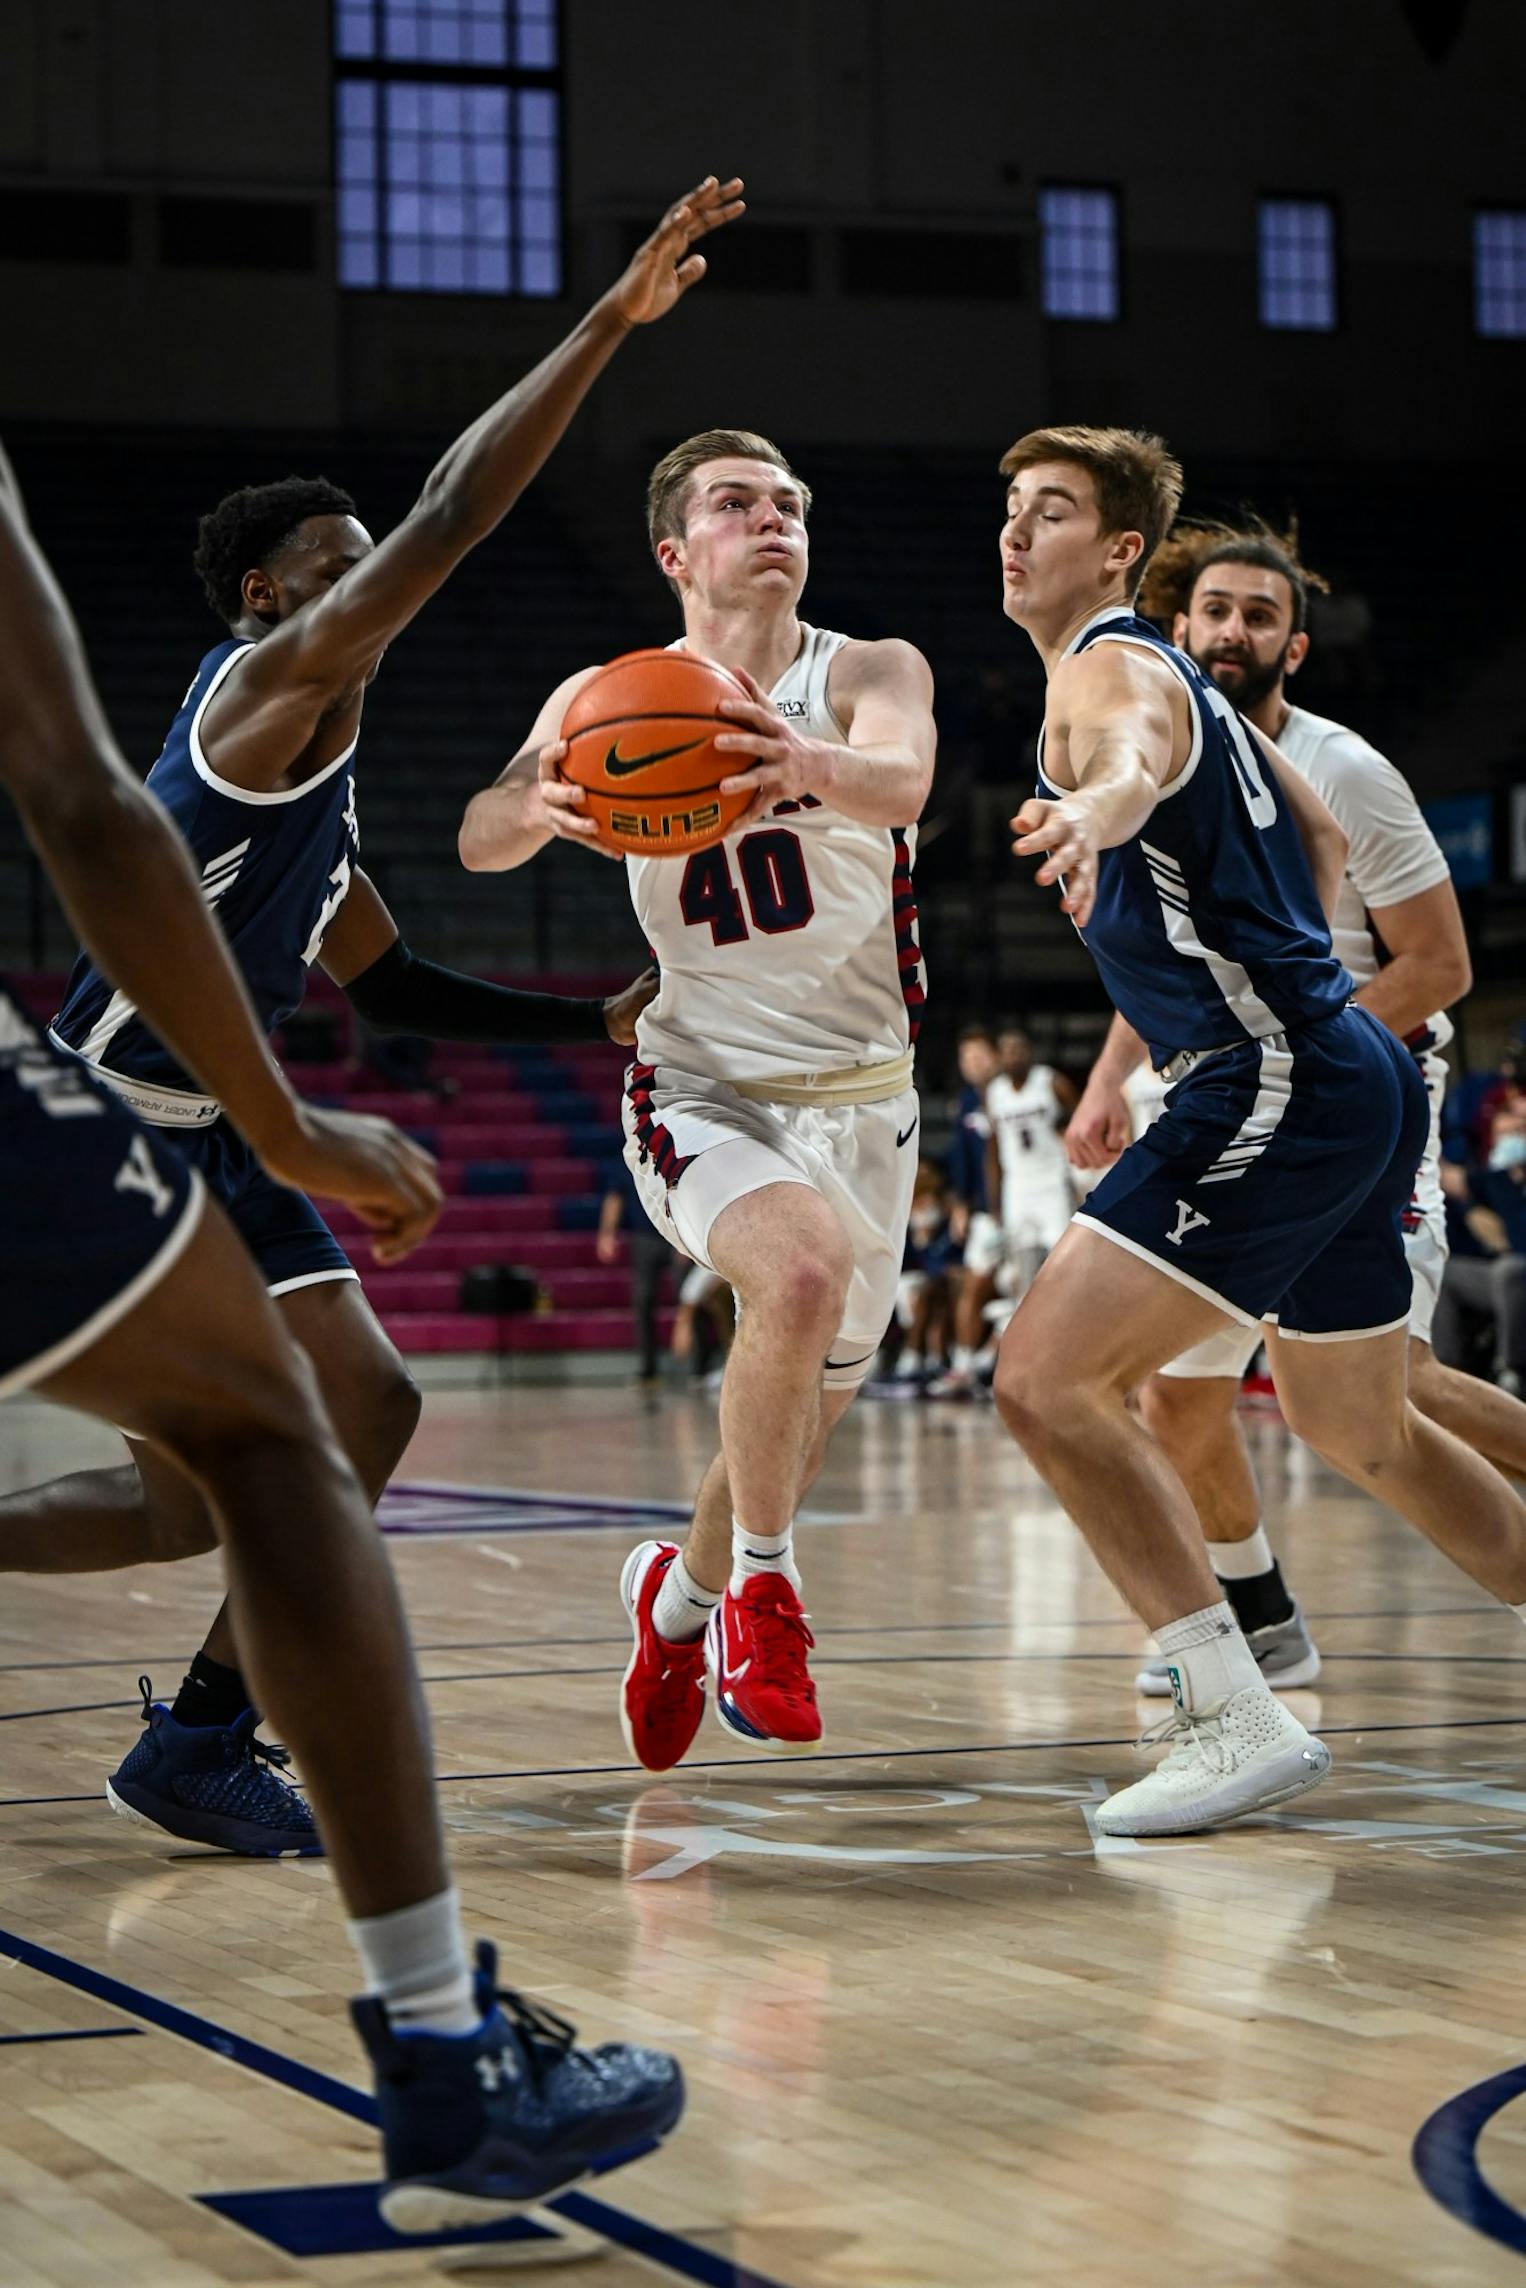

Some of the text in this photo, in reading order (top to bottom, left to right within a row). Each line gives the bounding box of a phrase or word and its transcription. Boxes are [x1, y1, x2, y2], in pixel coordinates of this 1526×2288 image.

[680, 828, 815, 947] 40
[118, 1093, 197, 1117] UNDER ARMOU
[1165, 1199, 1211, 1246] Y
